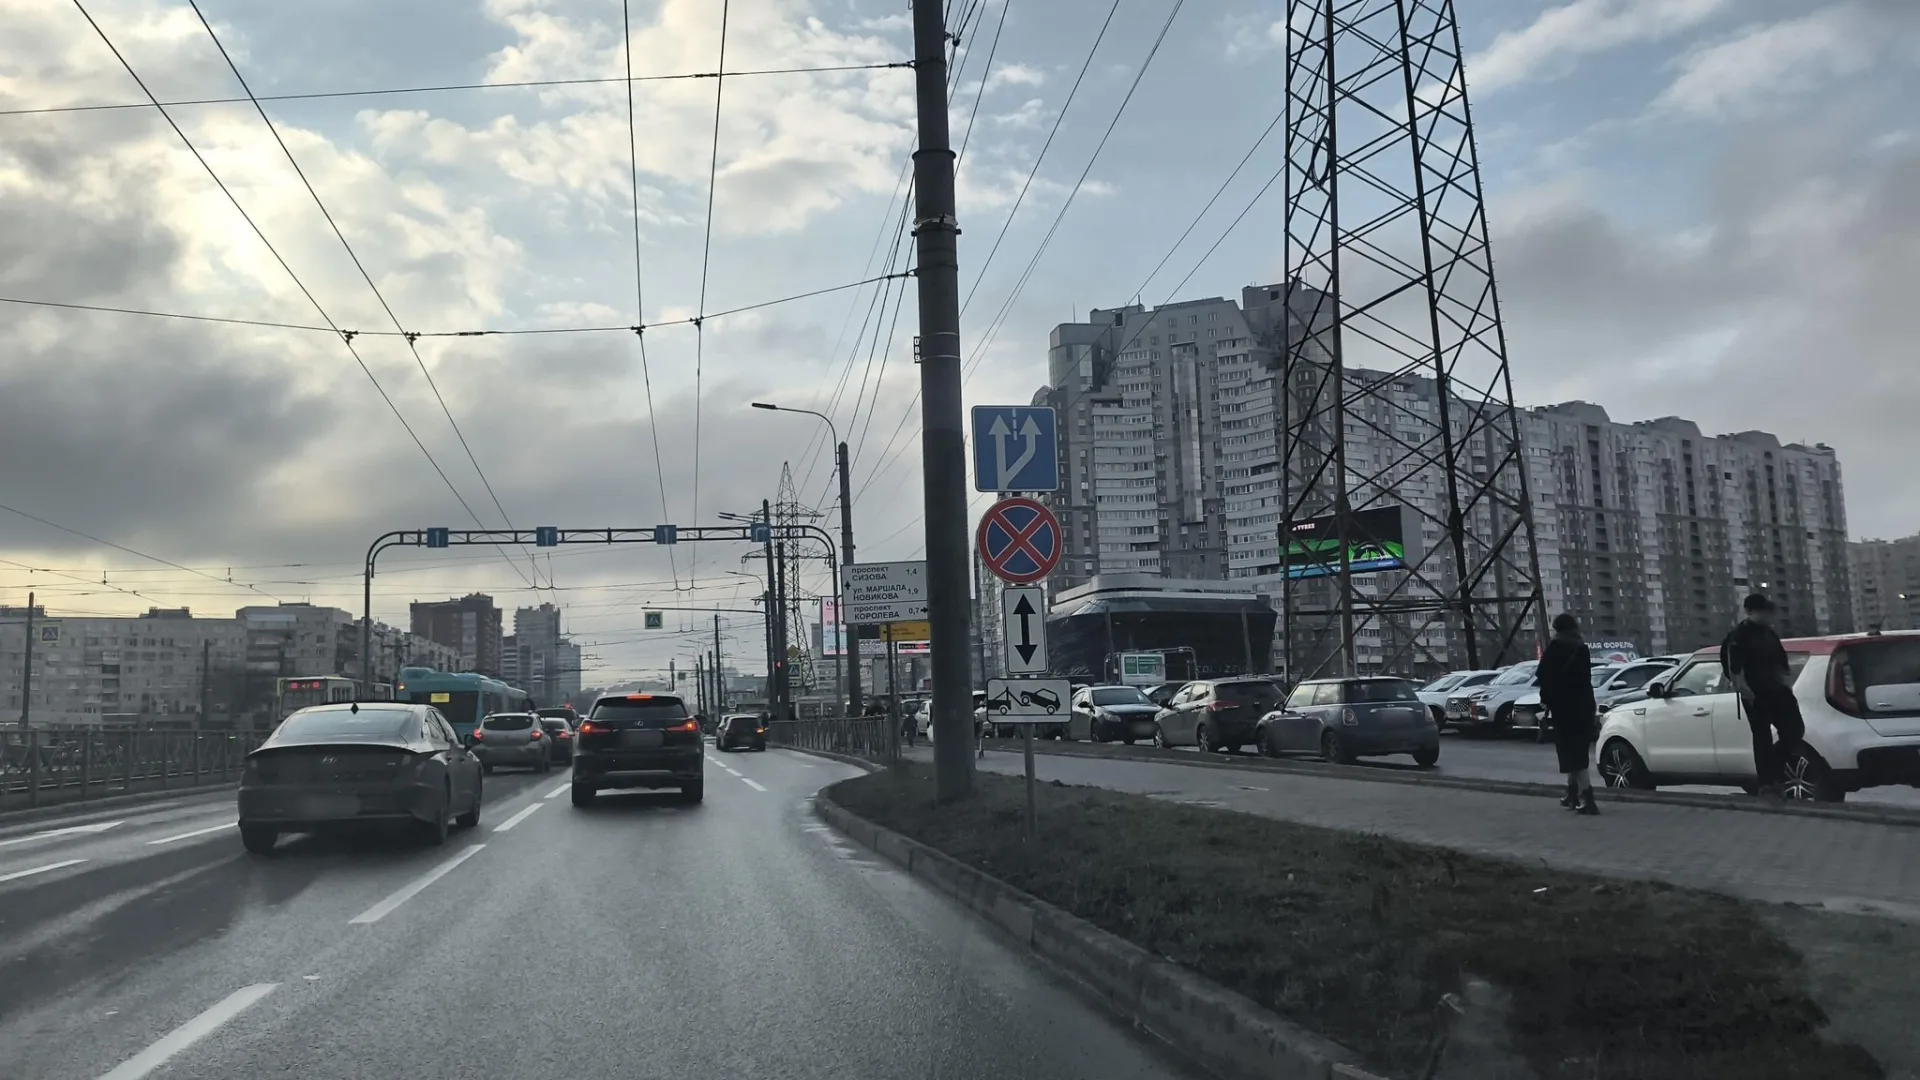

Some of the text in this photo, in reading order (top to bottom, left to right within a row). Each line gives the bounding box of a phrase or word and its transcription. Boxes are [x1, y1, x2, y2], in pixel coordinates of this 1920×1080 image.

[852, 566, 917, 576] проспект 1,4
[852, 573, 887, 581] СИЗОВА
[866, 584, 906, 593] МАРШАЛА
[908, 587, 919, 595] 1,9
[853, 593, 899, 601] НОВИКОВА
[854, 605, 891, 613] проспект
[854, 612, 900, 620] КОРОЛЕВА
[1603, 641, 1634, 649] ФОРЕЛЬ
